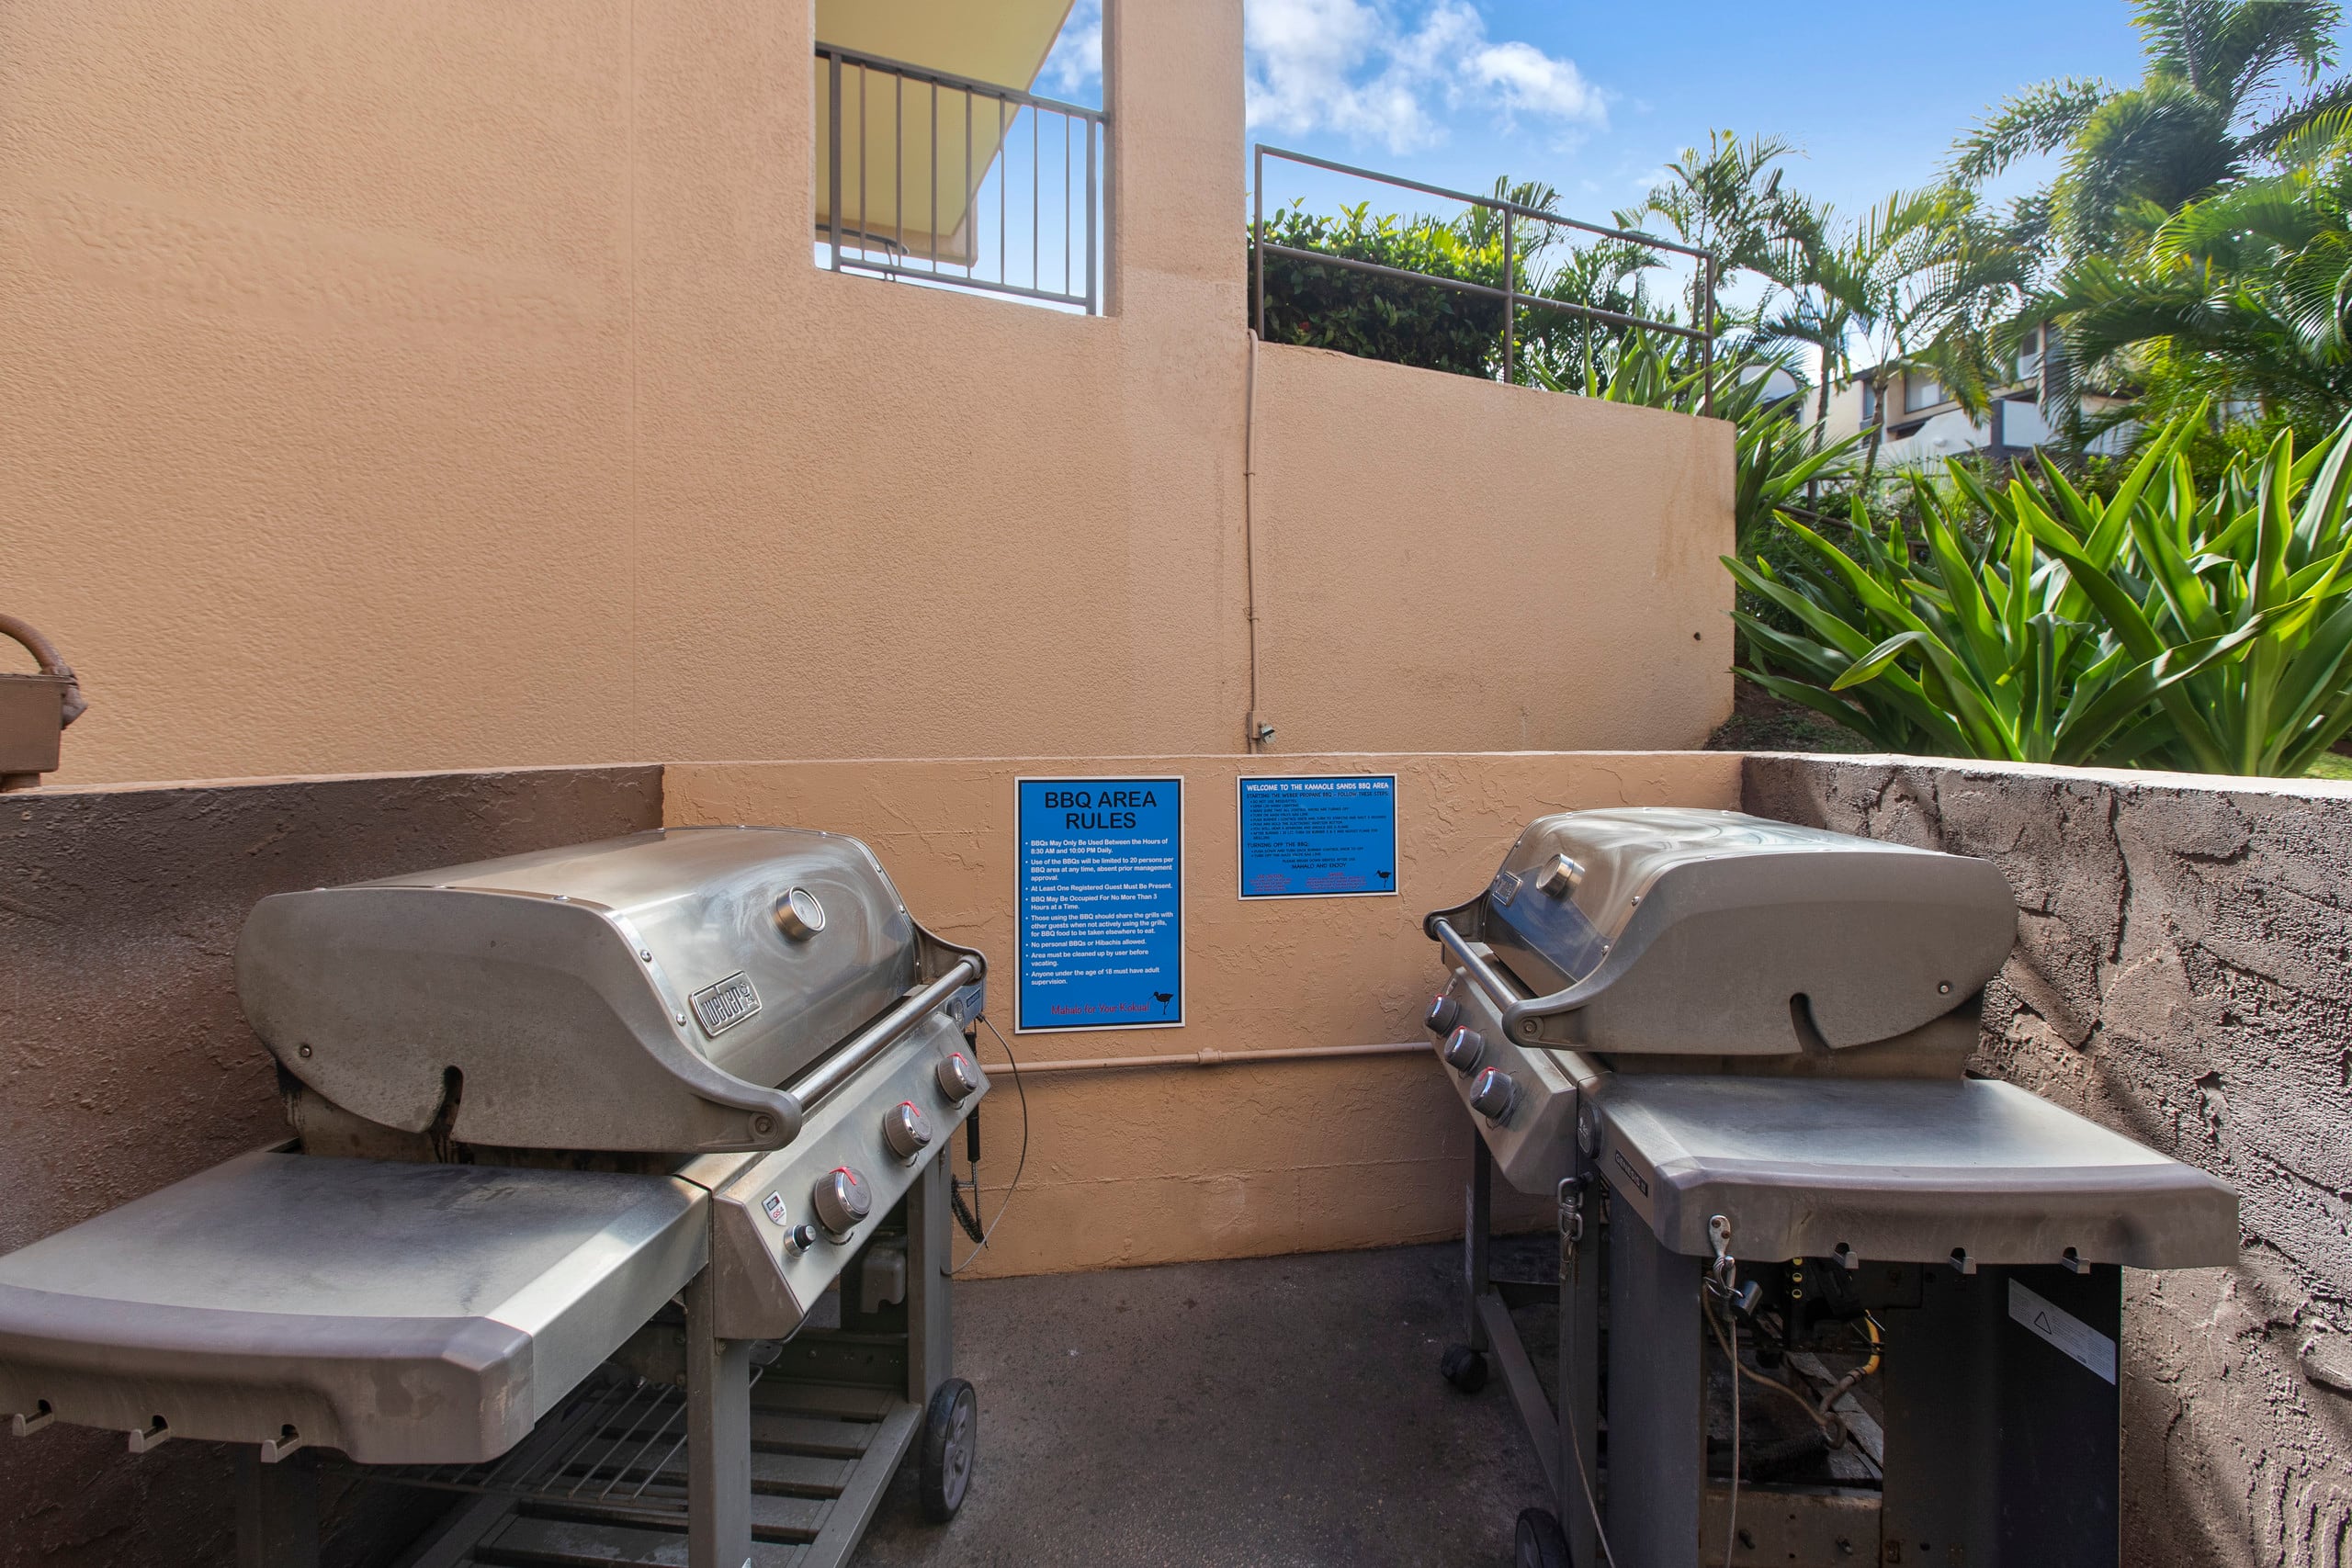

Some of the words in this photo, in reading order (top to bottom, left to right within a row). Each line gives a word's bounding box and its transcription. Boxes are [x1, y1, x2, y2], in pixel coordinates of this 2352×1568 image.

[1045, 791, 1091, 808] BBQ
[1097, 791, 1158, 807] AREA
[1066, 812, 1136, 829] RULES
[1051, 1005, 1082, 1015] Mahalo
[1084, 1003, 1096, 1013] for
[1099, 1003, 1118, 1013] Your
